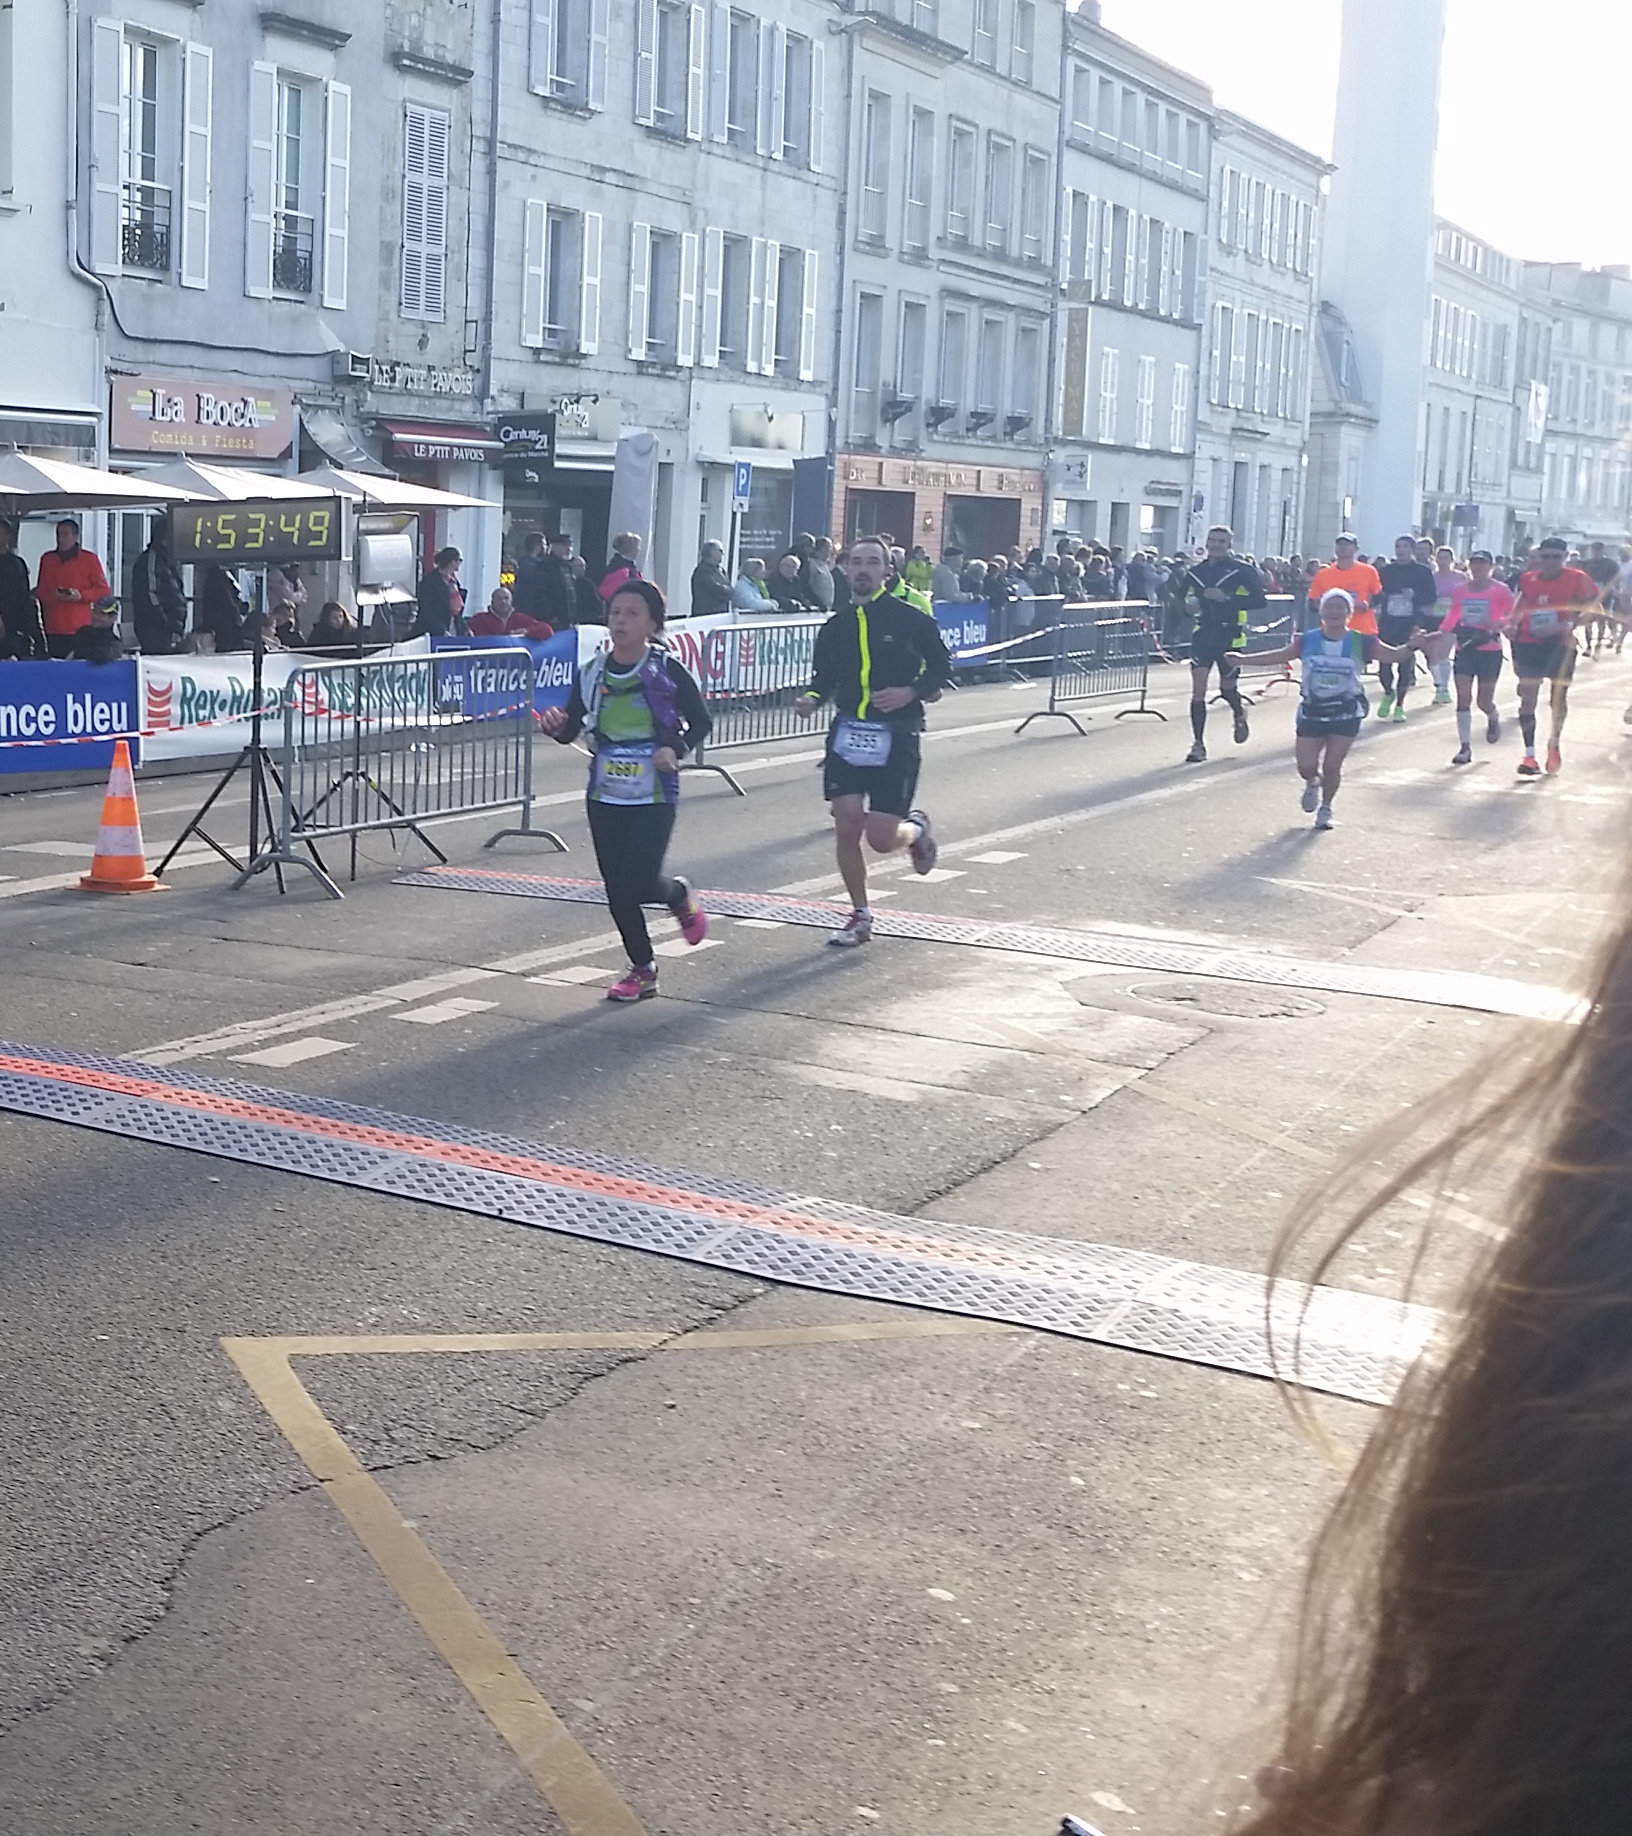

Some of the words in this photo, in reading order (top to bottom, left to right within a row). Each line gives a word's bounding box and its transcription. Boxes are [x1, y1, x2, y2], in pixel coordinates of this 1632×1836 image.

[374, 364, 391, 386] LE
[431, 370, 473, 395] PAVOIS
[152, 431, 193, 445] Comida
[216, 435, 254, 449] Fiesta
[500, 426, 540, 442] Century
[535, 434, 548, 450] 21
[414, 444, 425, 457] LE
[453, 447, 485, 461] PAVOIS
[738, 467, 747, 492] P
[194, 511, 330, 549] 1:53:49
[963, 620, 986, 645] bleu
[535, 656, 573, 689] bleu
[66, 693, 128, 735] bleu
